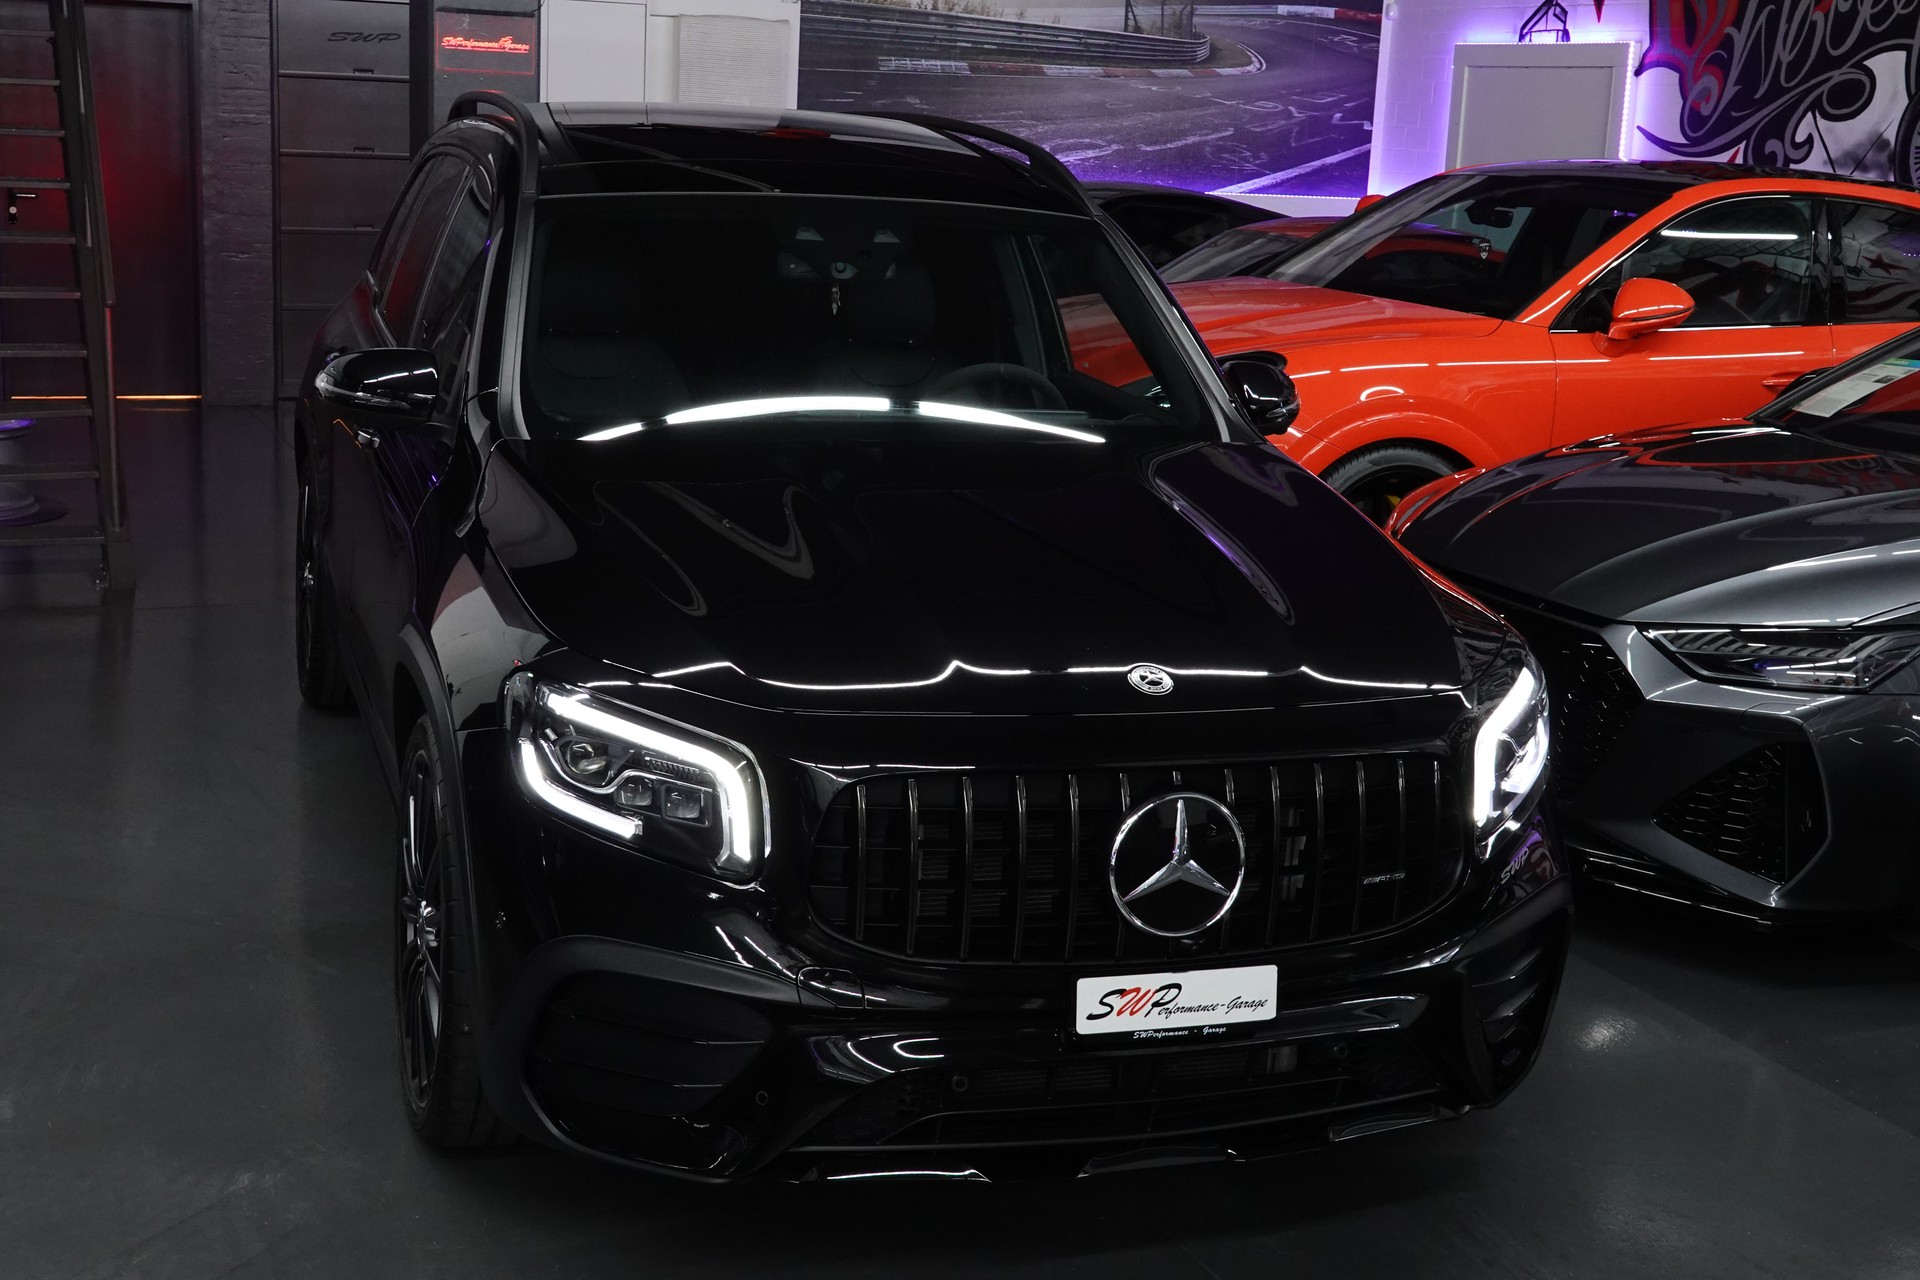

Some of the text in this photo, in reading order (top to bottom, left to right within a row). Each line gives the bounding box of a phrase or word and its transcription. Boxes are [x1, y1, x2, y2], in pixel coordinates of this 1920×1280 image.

[328, 31, 401, 43] SWP
[1133, 1029, 1189, 1039] SWPerformance
[1202, 1026, 1227, 1036] Garage
